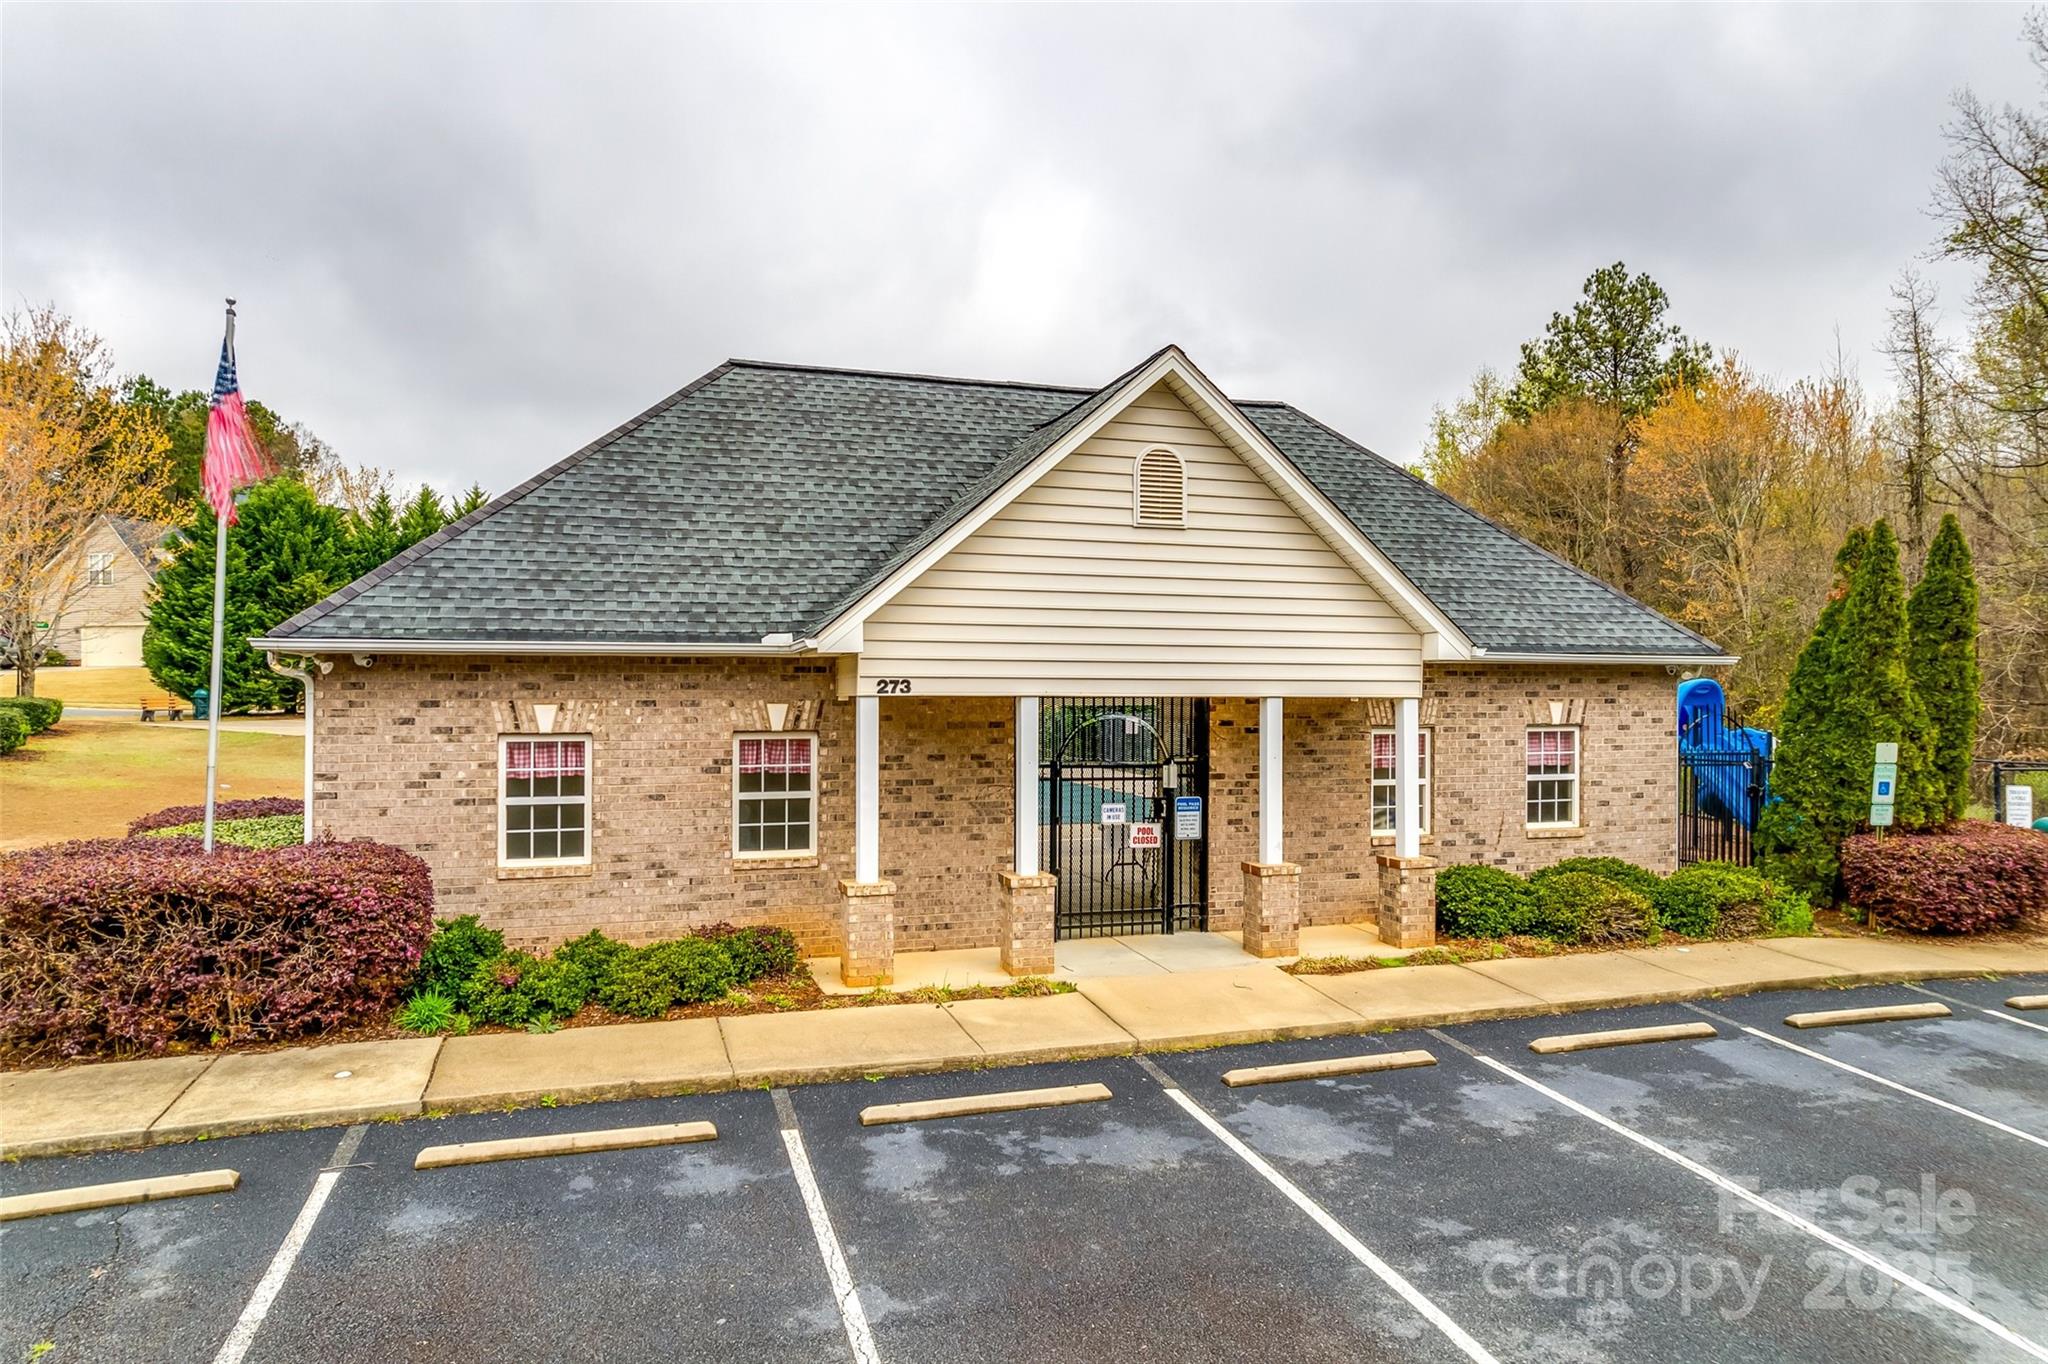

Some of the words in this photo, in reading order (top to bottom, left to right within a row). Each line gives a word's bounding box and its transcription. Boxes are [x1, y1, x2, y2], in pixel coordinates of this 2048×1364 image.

[877, 679, 912, 694] 273
[1137, 827, 1154, 835] POOL
[1132, 836, 1158, 844] CLOSED
